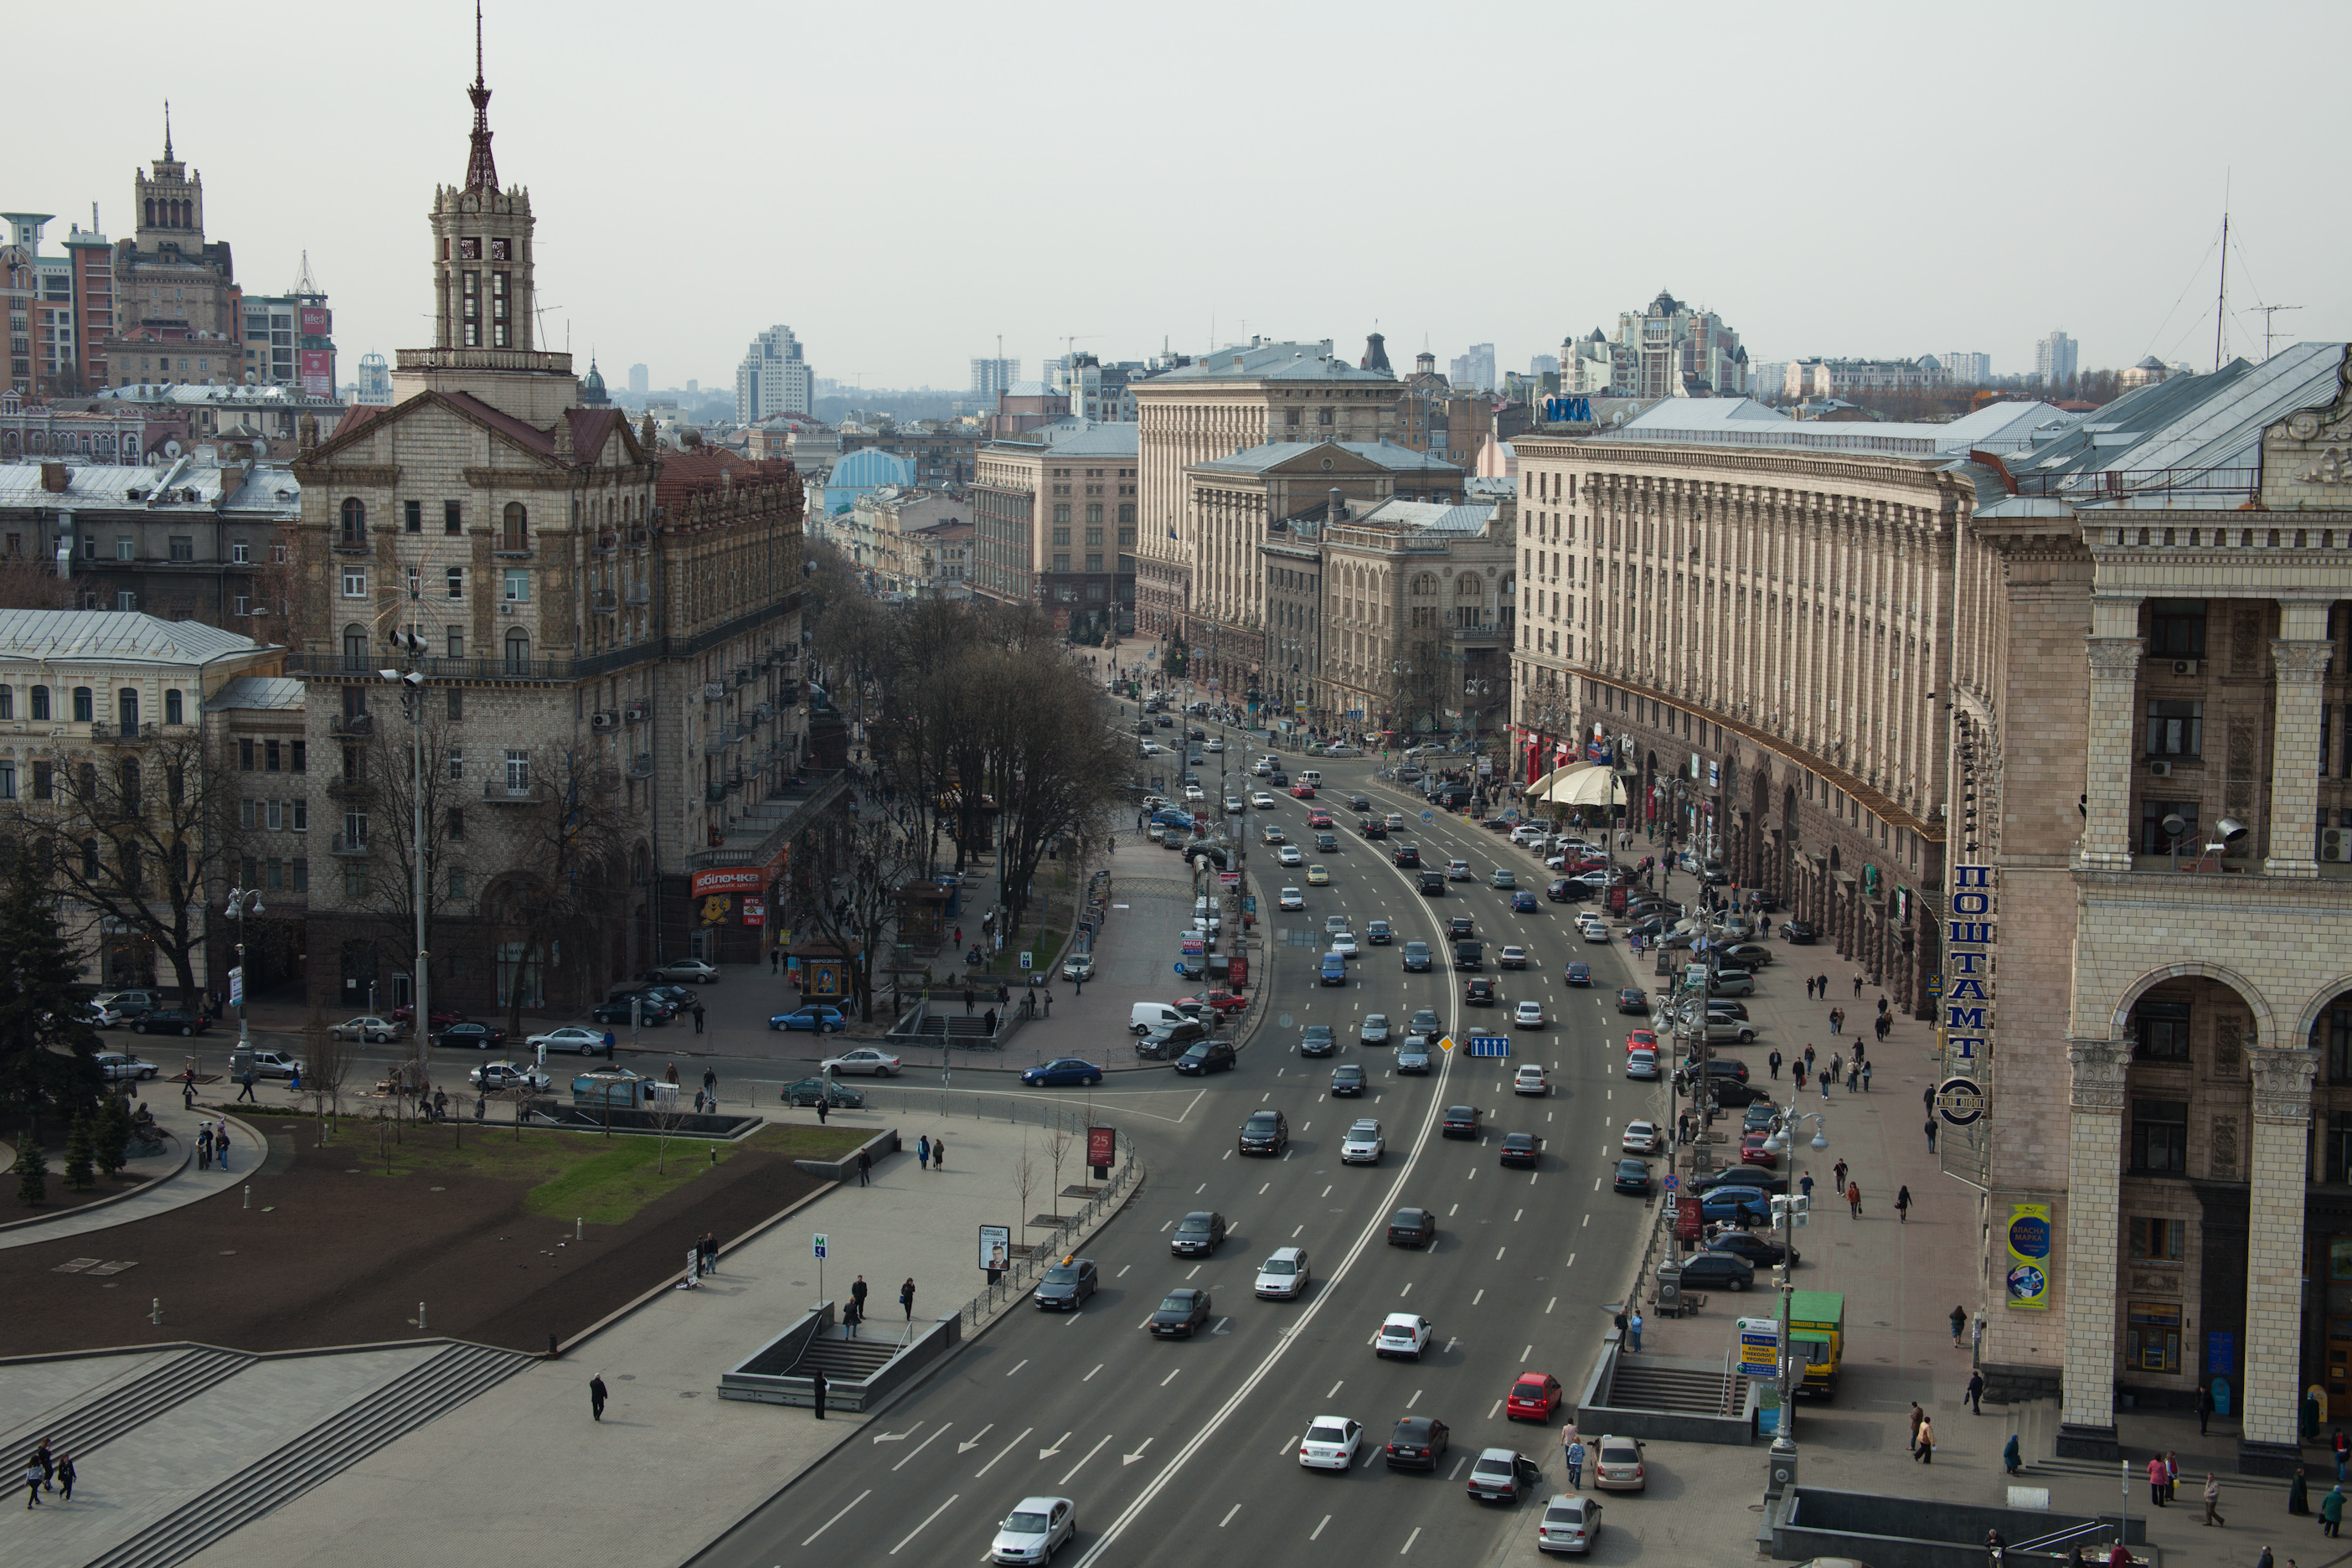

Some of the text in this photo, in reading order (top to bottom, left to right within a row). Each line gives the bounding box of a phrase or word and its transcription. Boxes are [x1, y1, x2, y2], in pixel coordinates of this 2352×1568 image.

[304, 313, 324, 325] life:)
[1547, 398, 1591, 421] NOKIA
[697, 874, 759, 888] мобілочка
[1231, 963, 1244, 972] 25
[1946, 865, 1992, 1059] ПОШТАМТ
[1092, 1135, 1108, 1147] 25
[2013, 1226, 2045, 1235] ВЛАСНА
[2014, 1234, 2043, 1242] МАРКА
